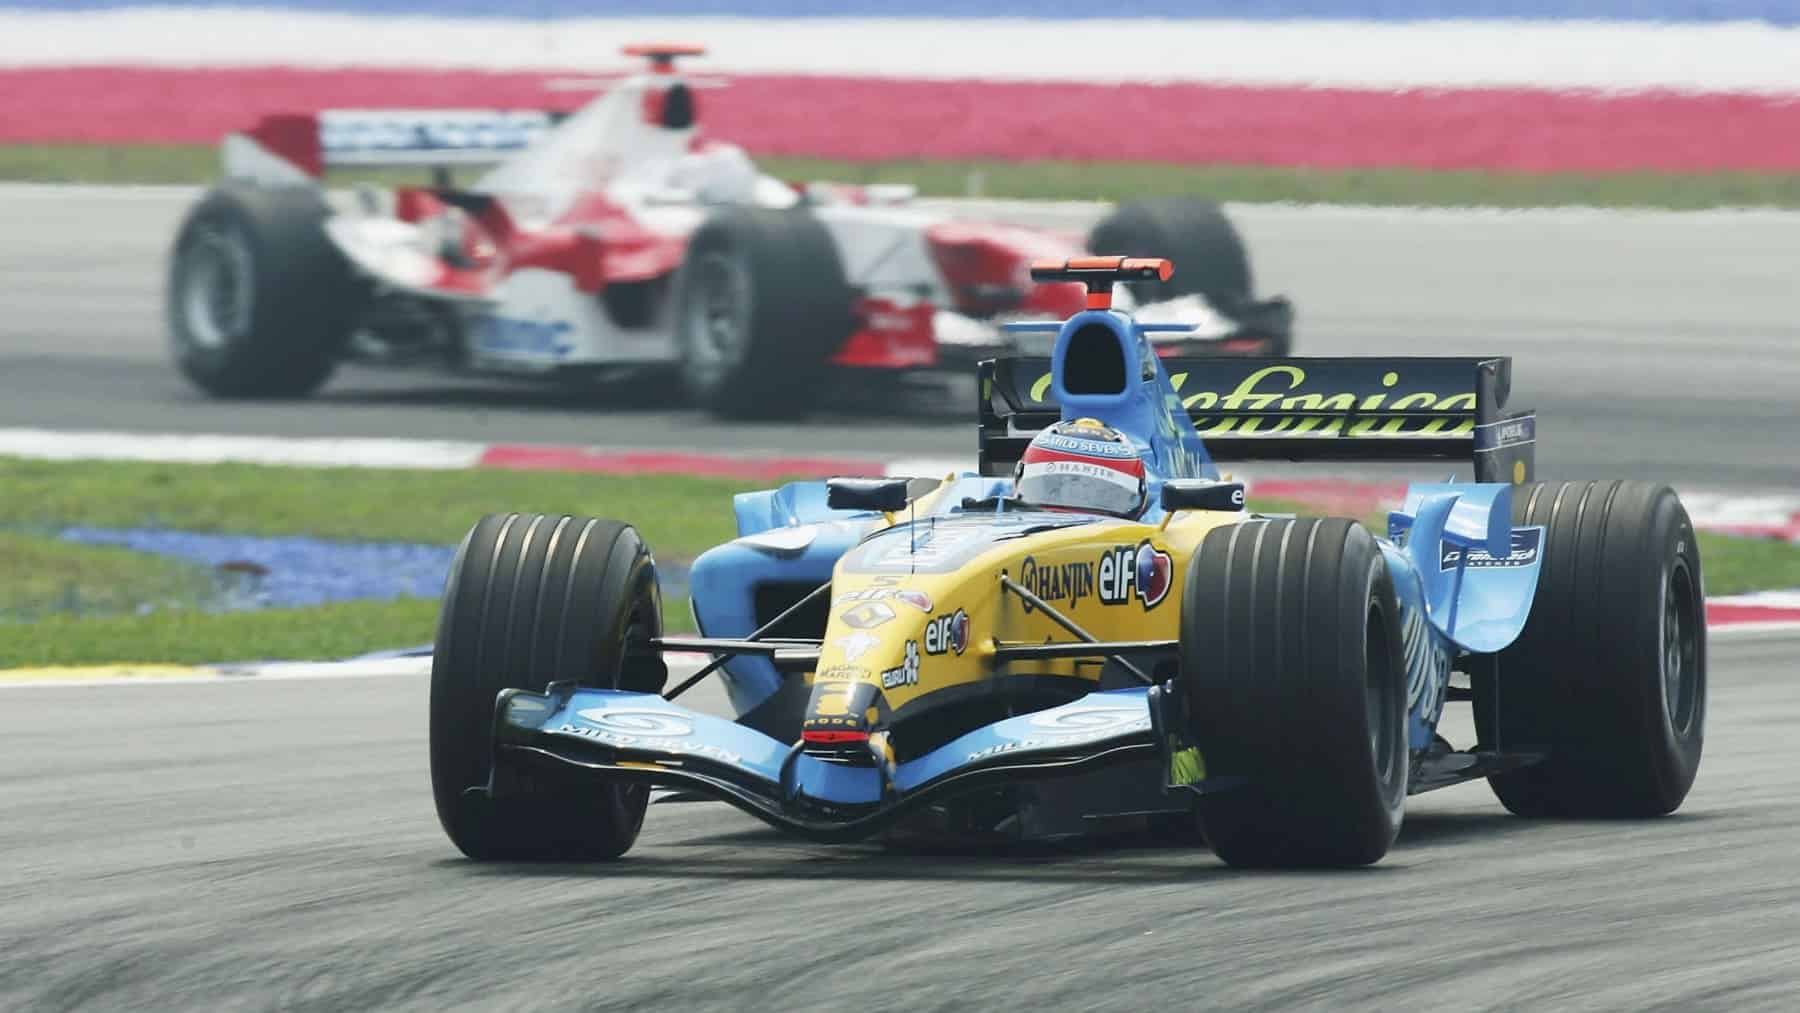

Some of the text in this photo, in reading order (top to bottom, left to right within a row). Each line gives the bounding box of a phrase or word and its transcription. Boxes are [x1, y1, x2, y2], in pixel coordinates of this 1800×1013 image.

[1038, 560, 1095, 609] HANJIN
[1099, 545, 1136, 602] elf
[926, 616, 953, 655] elf
